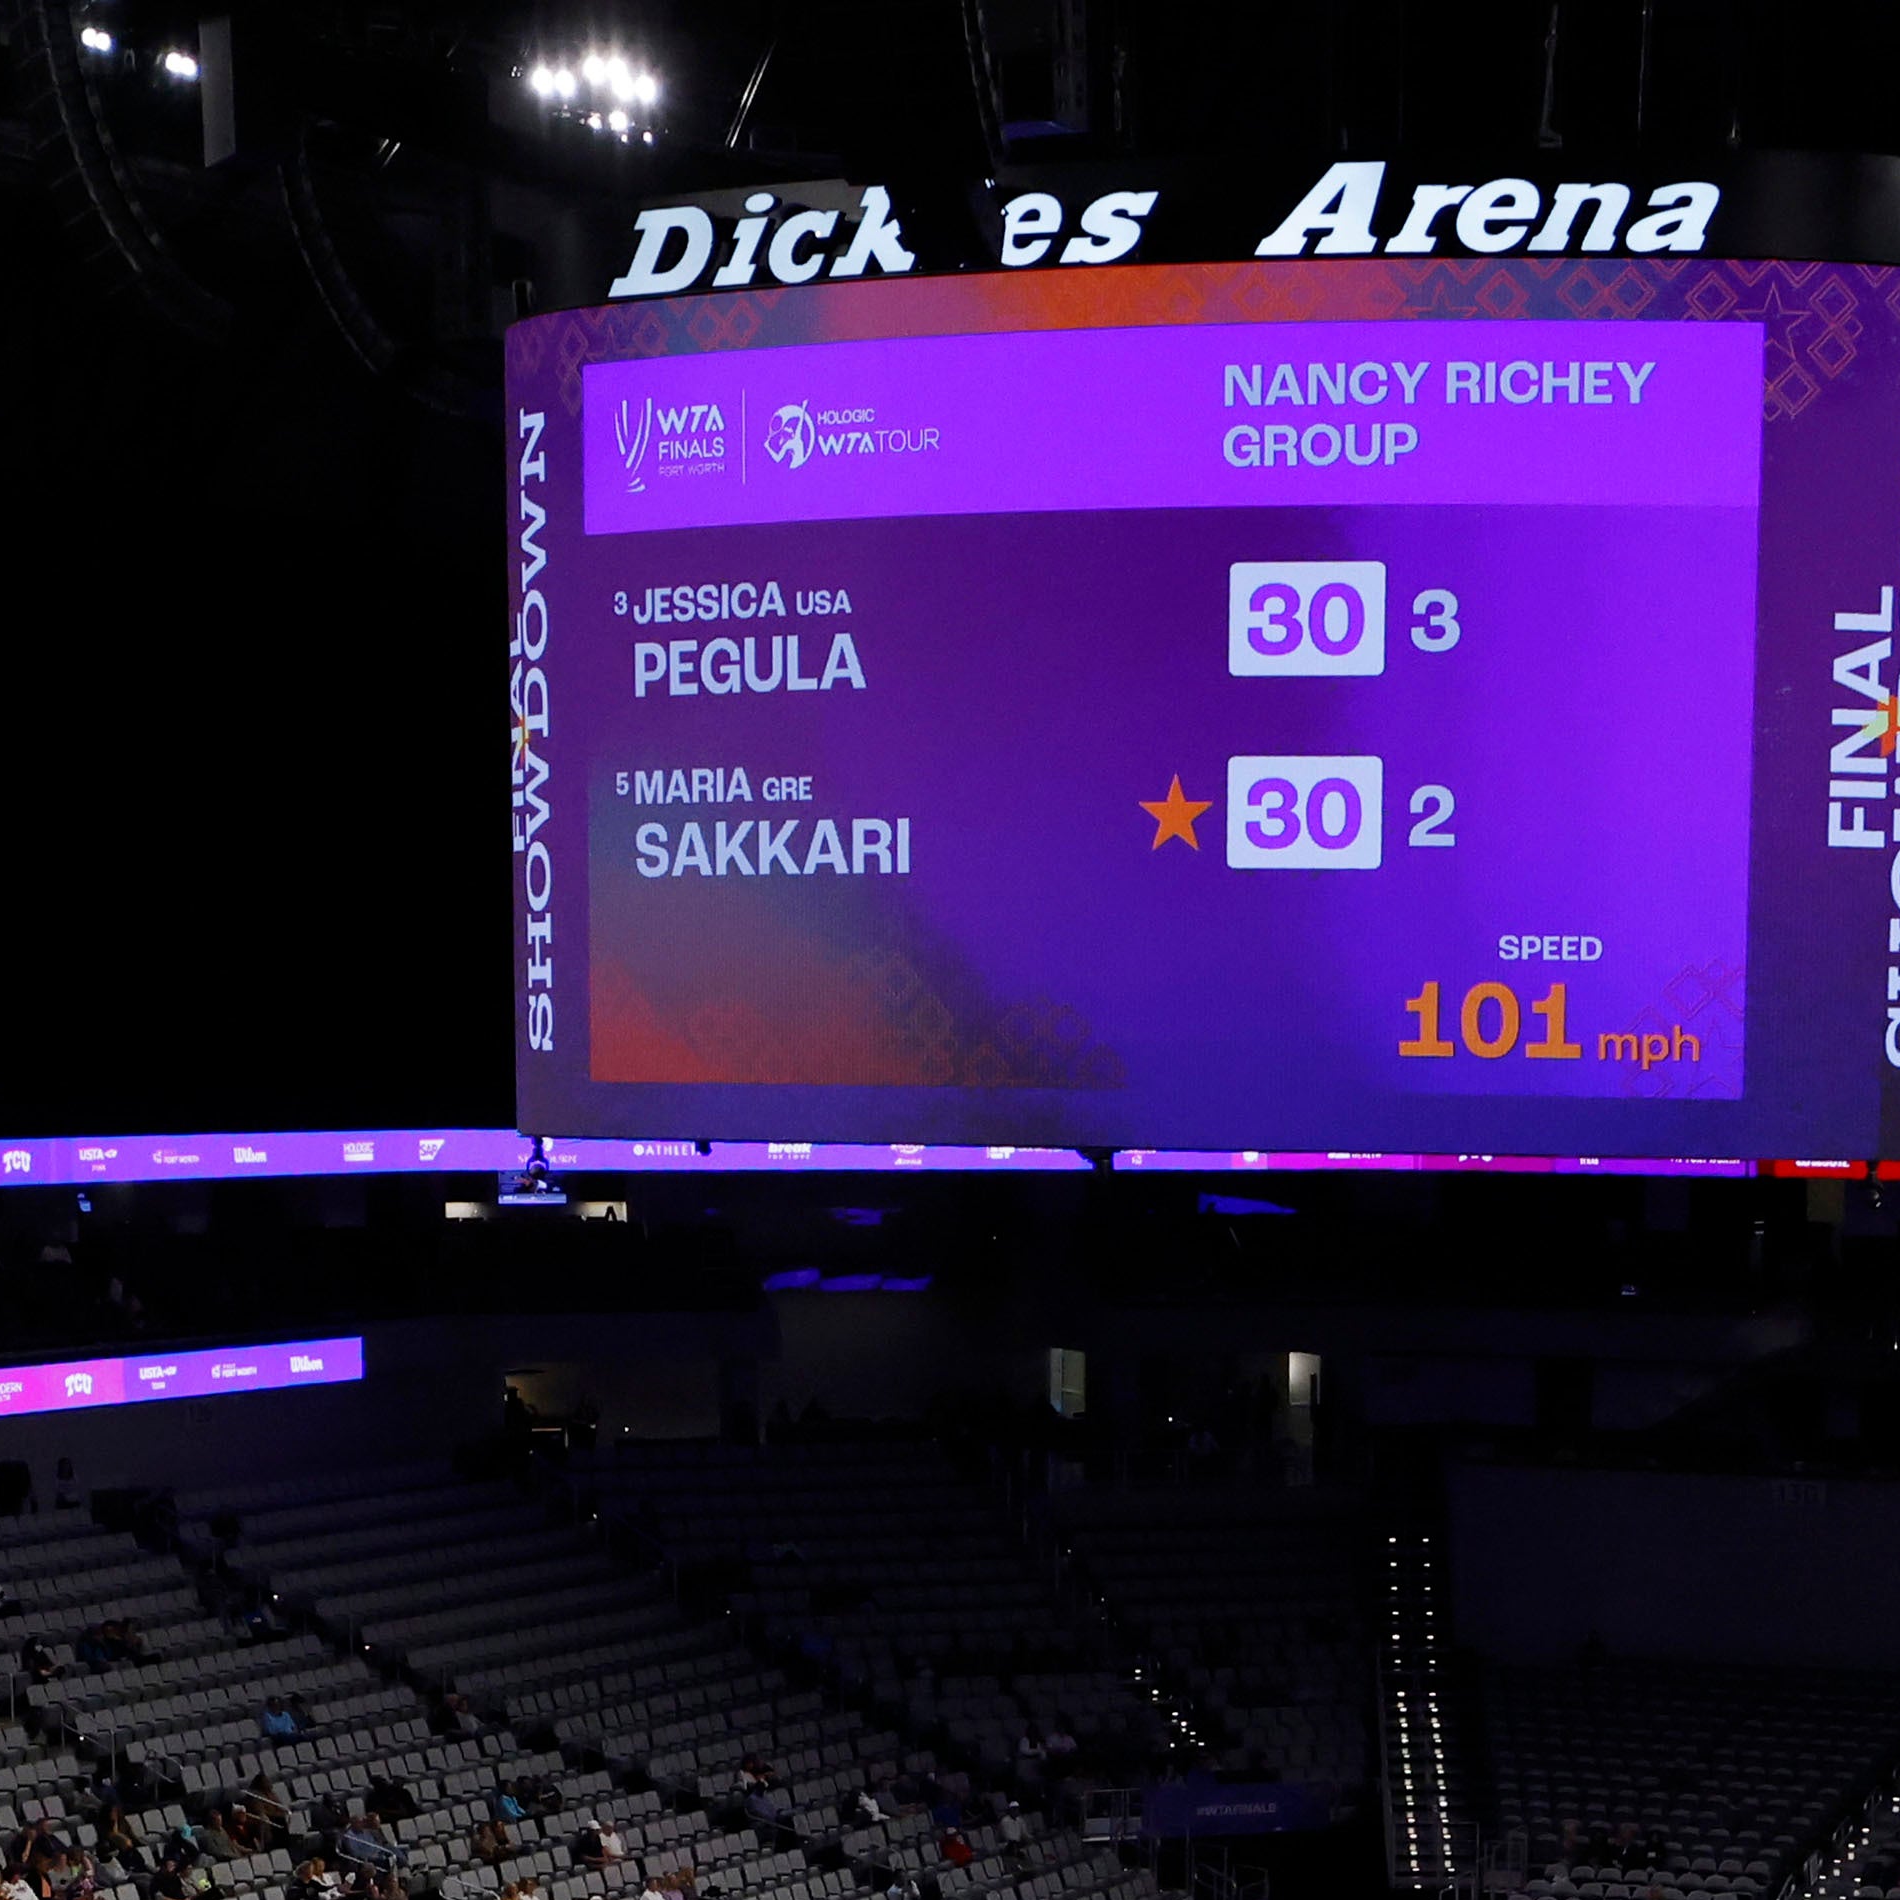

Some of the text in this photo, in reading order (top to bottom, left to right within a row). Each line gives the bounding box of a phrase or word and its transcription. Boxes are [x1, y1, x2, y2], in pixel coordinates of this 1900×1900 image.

[608, 161, 1720, 297] Dickes Arena
[1223, 361, 1656, 407] NANCY RICHEY
[656, 404, 725, 435] WTA
[817, 407, 875, 426] HOLOGIC
[658, 437, 725, 460] FINALS
[1222, 423, 1419, 468] GROUP
[659, 463, 725, 477] FORT WORTH
[614, 581, 852, 625] 3 JESSICA USA
[1246, 581, 1461, 656] 30 3
[634, 632, 867, 698] PEGULA
[509, 612, 527, 852] FINAL
[518, 407, 553, 1050] SHOWDOWN
[1827, 586, 1894, 848] FINAL
[615, 767, 813, 805] 5 MARIA GRE
[1244, 777, 1456, 850] 30 2
[635, 817, 911, 879] SAKKARI
[1498, 935, 1603, 961] SPEED
[1398, 980, 1701, 1071] 101 mph
[65, 1373, 92, 1397] TCU
